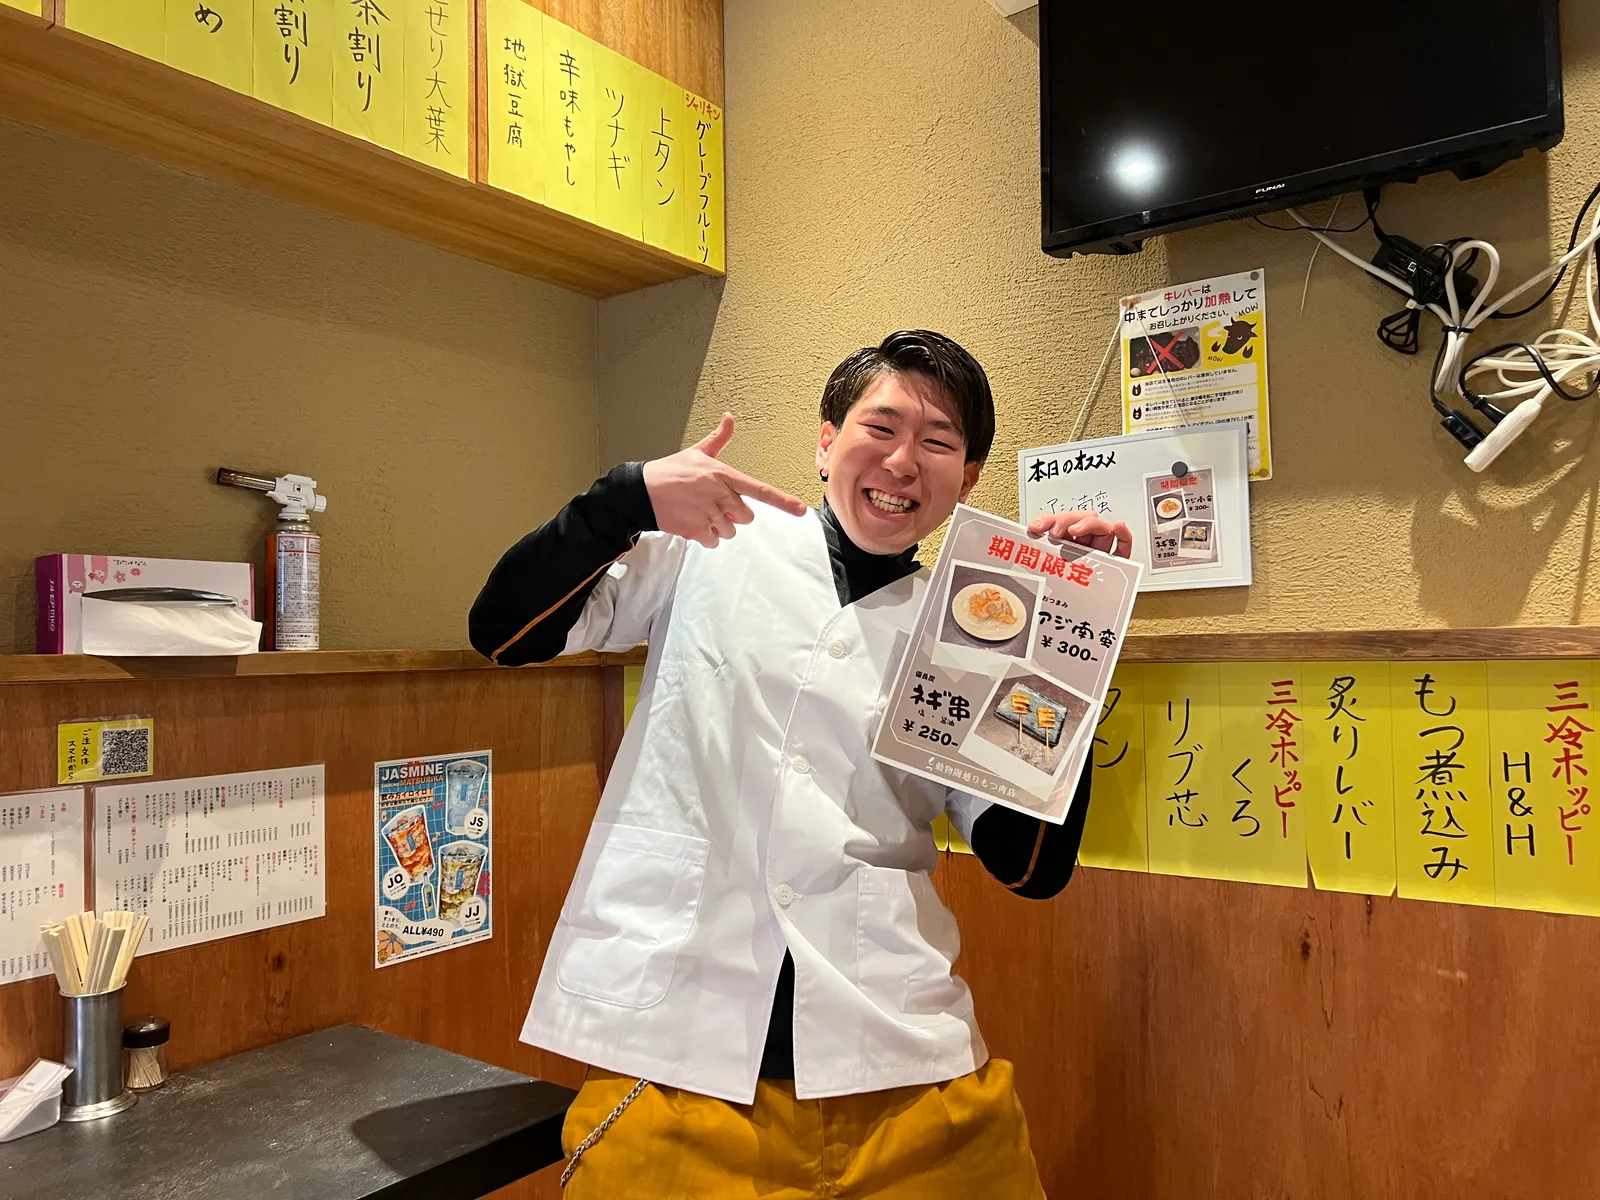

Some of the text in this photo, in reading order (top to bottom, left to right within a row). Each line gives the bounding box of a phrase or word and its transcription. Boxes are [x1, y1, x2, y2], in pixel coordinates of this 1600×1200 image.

[273, 0, 308, 85] 割り
[424, 0, 453, 155] せり大葉
[503, 37, 528, 149] 地獄豆腐
[559, 50, 582, 186] 辛味もやし
[685, 93, 721, 121] シャリキン
[605, 88, 631, 189] ツナギ
[651, 107, 675, 206] 上タン
[696, 120, 712, 264] グレープフルーツ
[1255, 183, 1286, 194] FUNAI
[1124, 287, 1257, 323] 中までしっかり加熱して
[1164, 284, 1212, 302] 牛レバーは
[1149, 309, 1229, 331] お召し上がりください。
[1027, 450, 1116, 483] 本日のオススメ
[987, 534, 1094, 588] 期間限定
[1042, 595, 1068, 609] おつまみ
[1038, 611, 1117, 649] アジ南蛮
[910, 684, 970, 722] ネギ串
[67, 740, 76, 780] スマホから
[81, 728, 92, 765] ご注文は
[1165, 698, 1208, 827] リブ芯
[1264, 680, 1303, 839] 三冷ホッピー
[381, 763, 444, 781] JASMINE
[401, 775, 444, 786] MATSURIKA
[1325, 676, 1374, 859] 炙りレバー
[1413, 673, 1469, 882] もつ煮込み
[1543, 681, 1595, 866] 三冷ホッピー
[1231, 758, 1260, 837] くろ
[1502, 751, 1535, 857] H&H
[470, 816, 484, 827] JS
[387, 873, 403, 889] JO
[402, 925, 444, 937] ALL¥490
[465, 905, 480, 919] JJ
